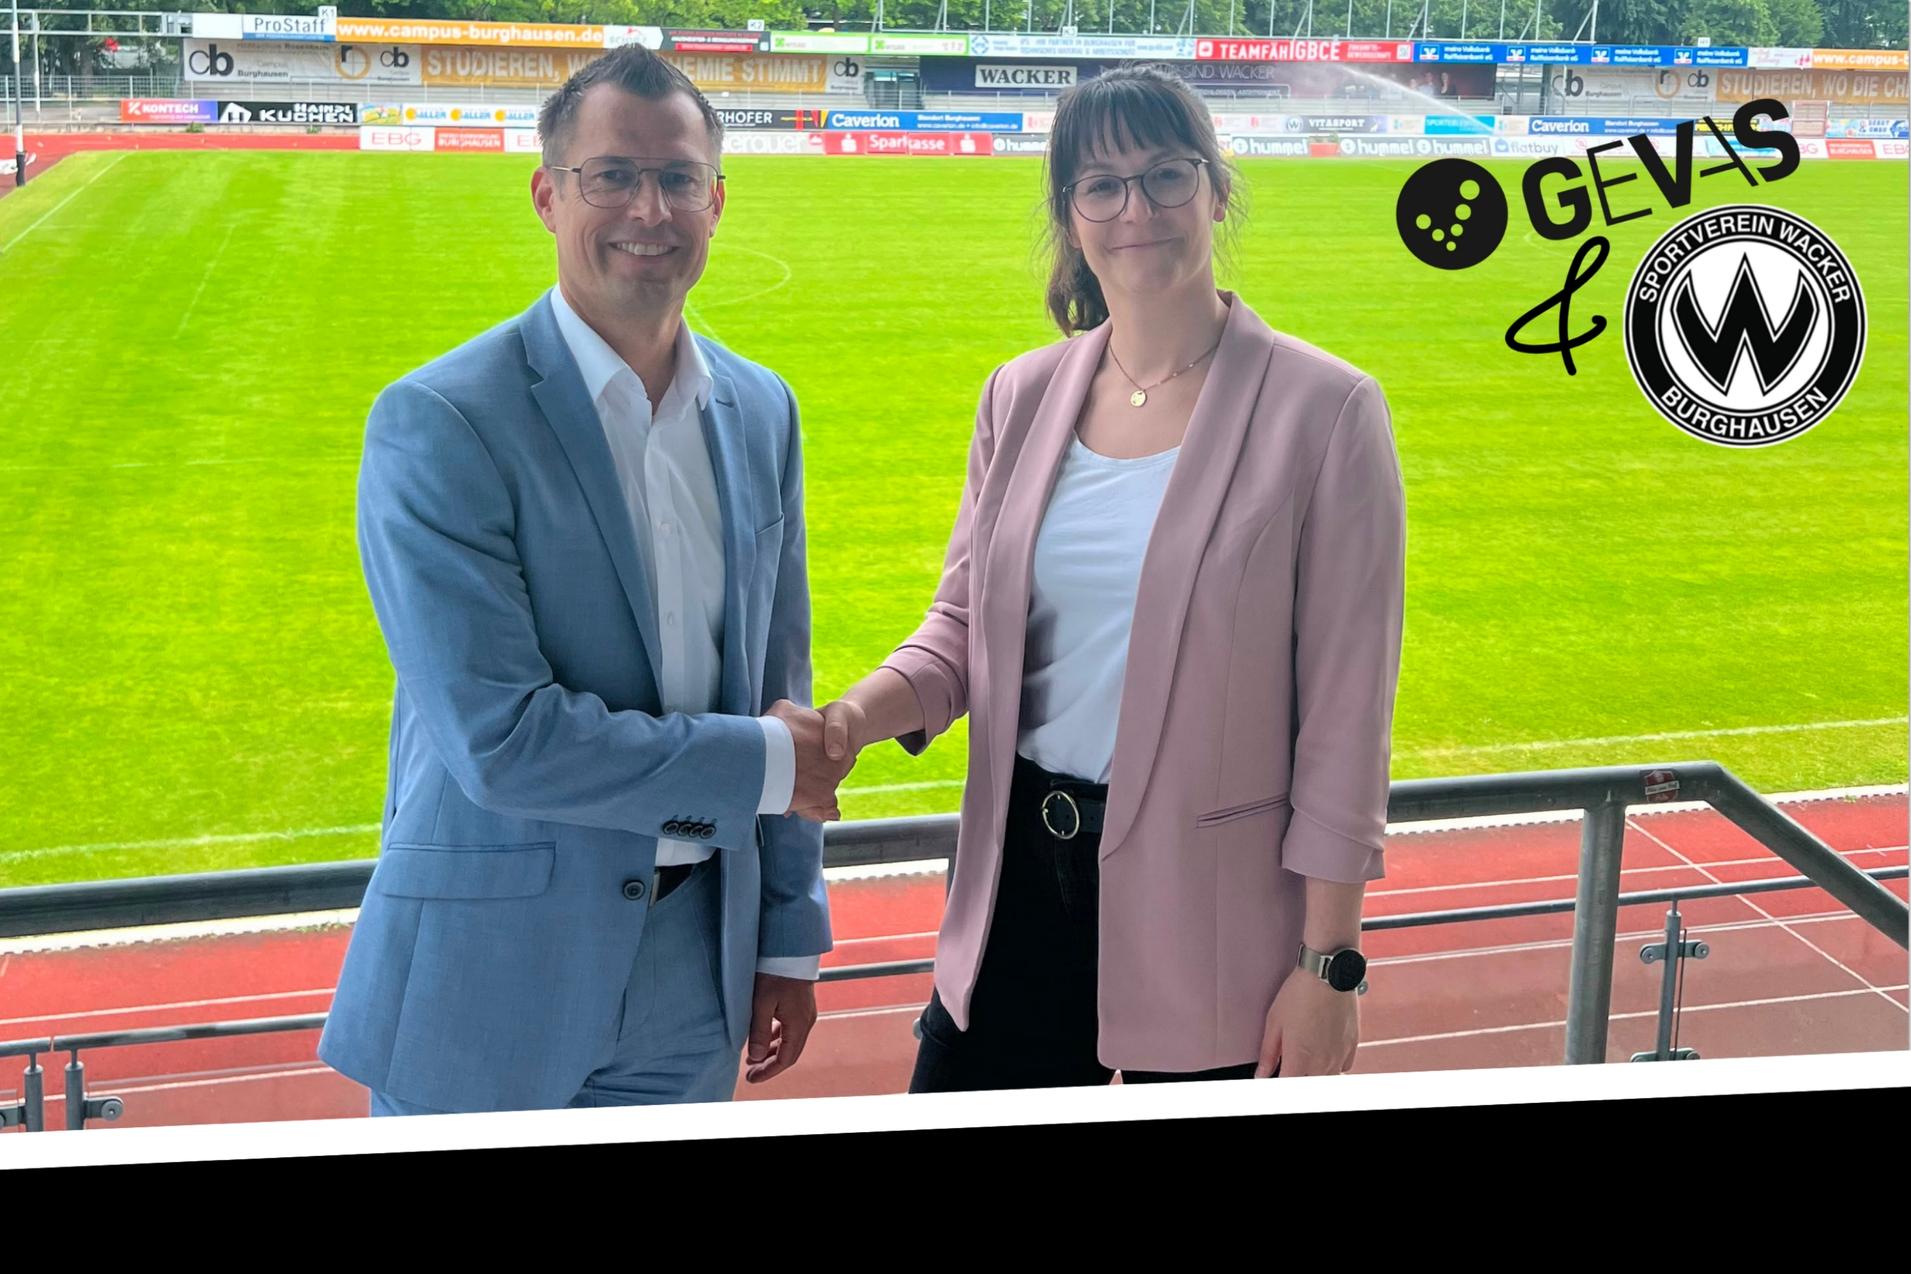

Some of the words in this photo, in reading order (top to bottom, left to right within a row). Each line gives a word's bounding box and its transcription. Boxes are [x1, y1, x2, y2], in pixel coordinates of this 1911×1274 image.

[254, 17, 326, 33] ProStaff
[338, 24, 604, 42] www.campus-burghausen.de
[238, 70, 288, 78] Burghausen
[427, 51, 560, 82] STUDIEREN,
[742, 58, 821, 82] STIMMT
[1219, 64, 1274, 80] WACKER
[980, 69, 1071, 84] WACKER
[1721, 73, 1816, 98] STUDIEREN,
[1823, 74, 1847, 96] WO
[1852, 75, 1878, 97] DIE
[142, 103, 198, 114] KONTECH
[832, 113, 899, 127] Caverion
[1308, 119, 1365, 127] VITASPORT
[1532, 119, 1589, 132] Caverion
[371, 132, 421, 145] EBG
[869, 134, 945, 149] Sparkasse
[1251, 139, 1307, 155] hummel
[1358, 139, 1413, 155] hummel
[1432, 139, 1488, 155] hummel
